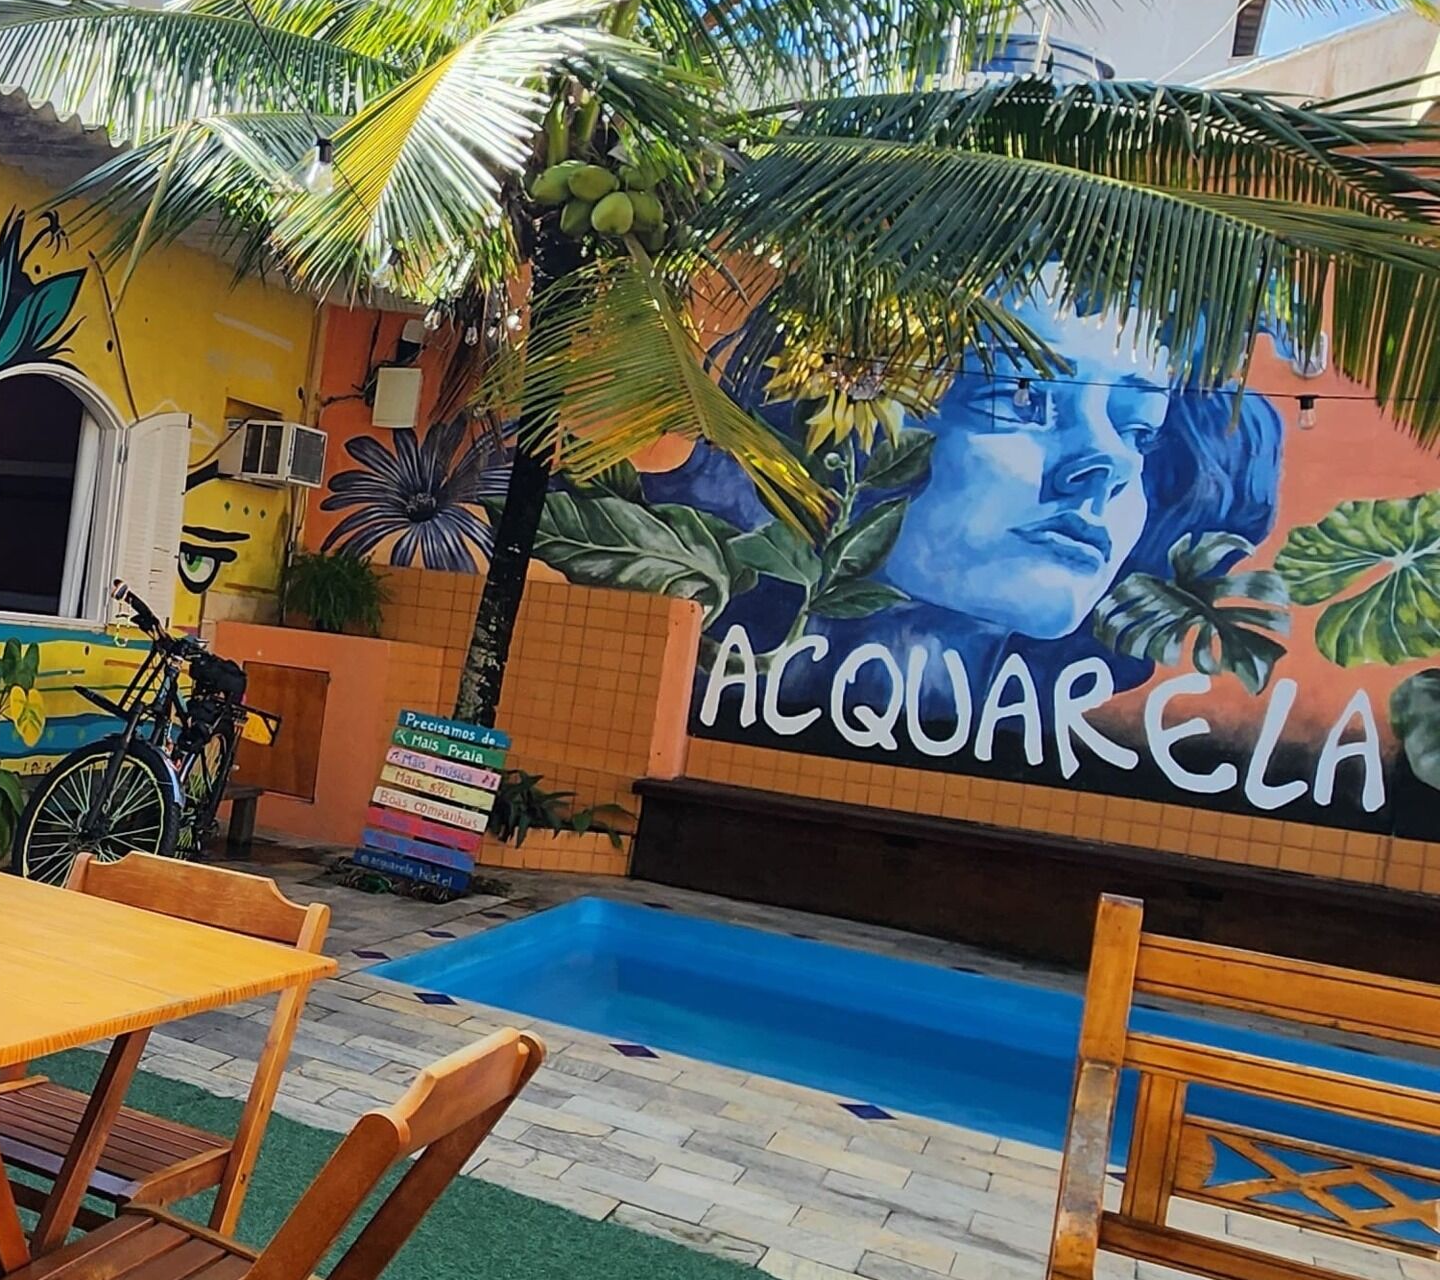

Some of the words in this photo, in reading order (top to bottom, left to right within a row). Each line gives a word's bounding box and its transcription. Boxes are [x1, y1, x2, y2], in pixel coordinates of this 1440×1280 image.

[404, 712, 476, 741] Precisamos
[699, 623, 1387, 812] ACQUARELA
[411, 734, 439, 752] Mais
[447, 743, 484, 764] Praia
[402, 753, 426, 770] Mais
[434, 763, 472, 782] música
[379, 790, 407, 808] Boas
